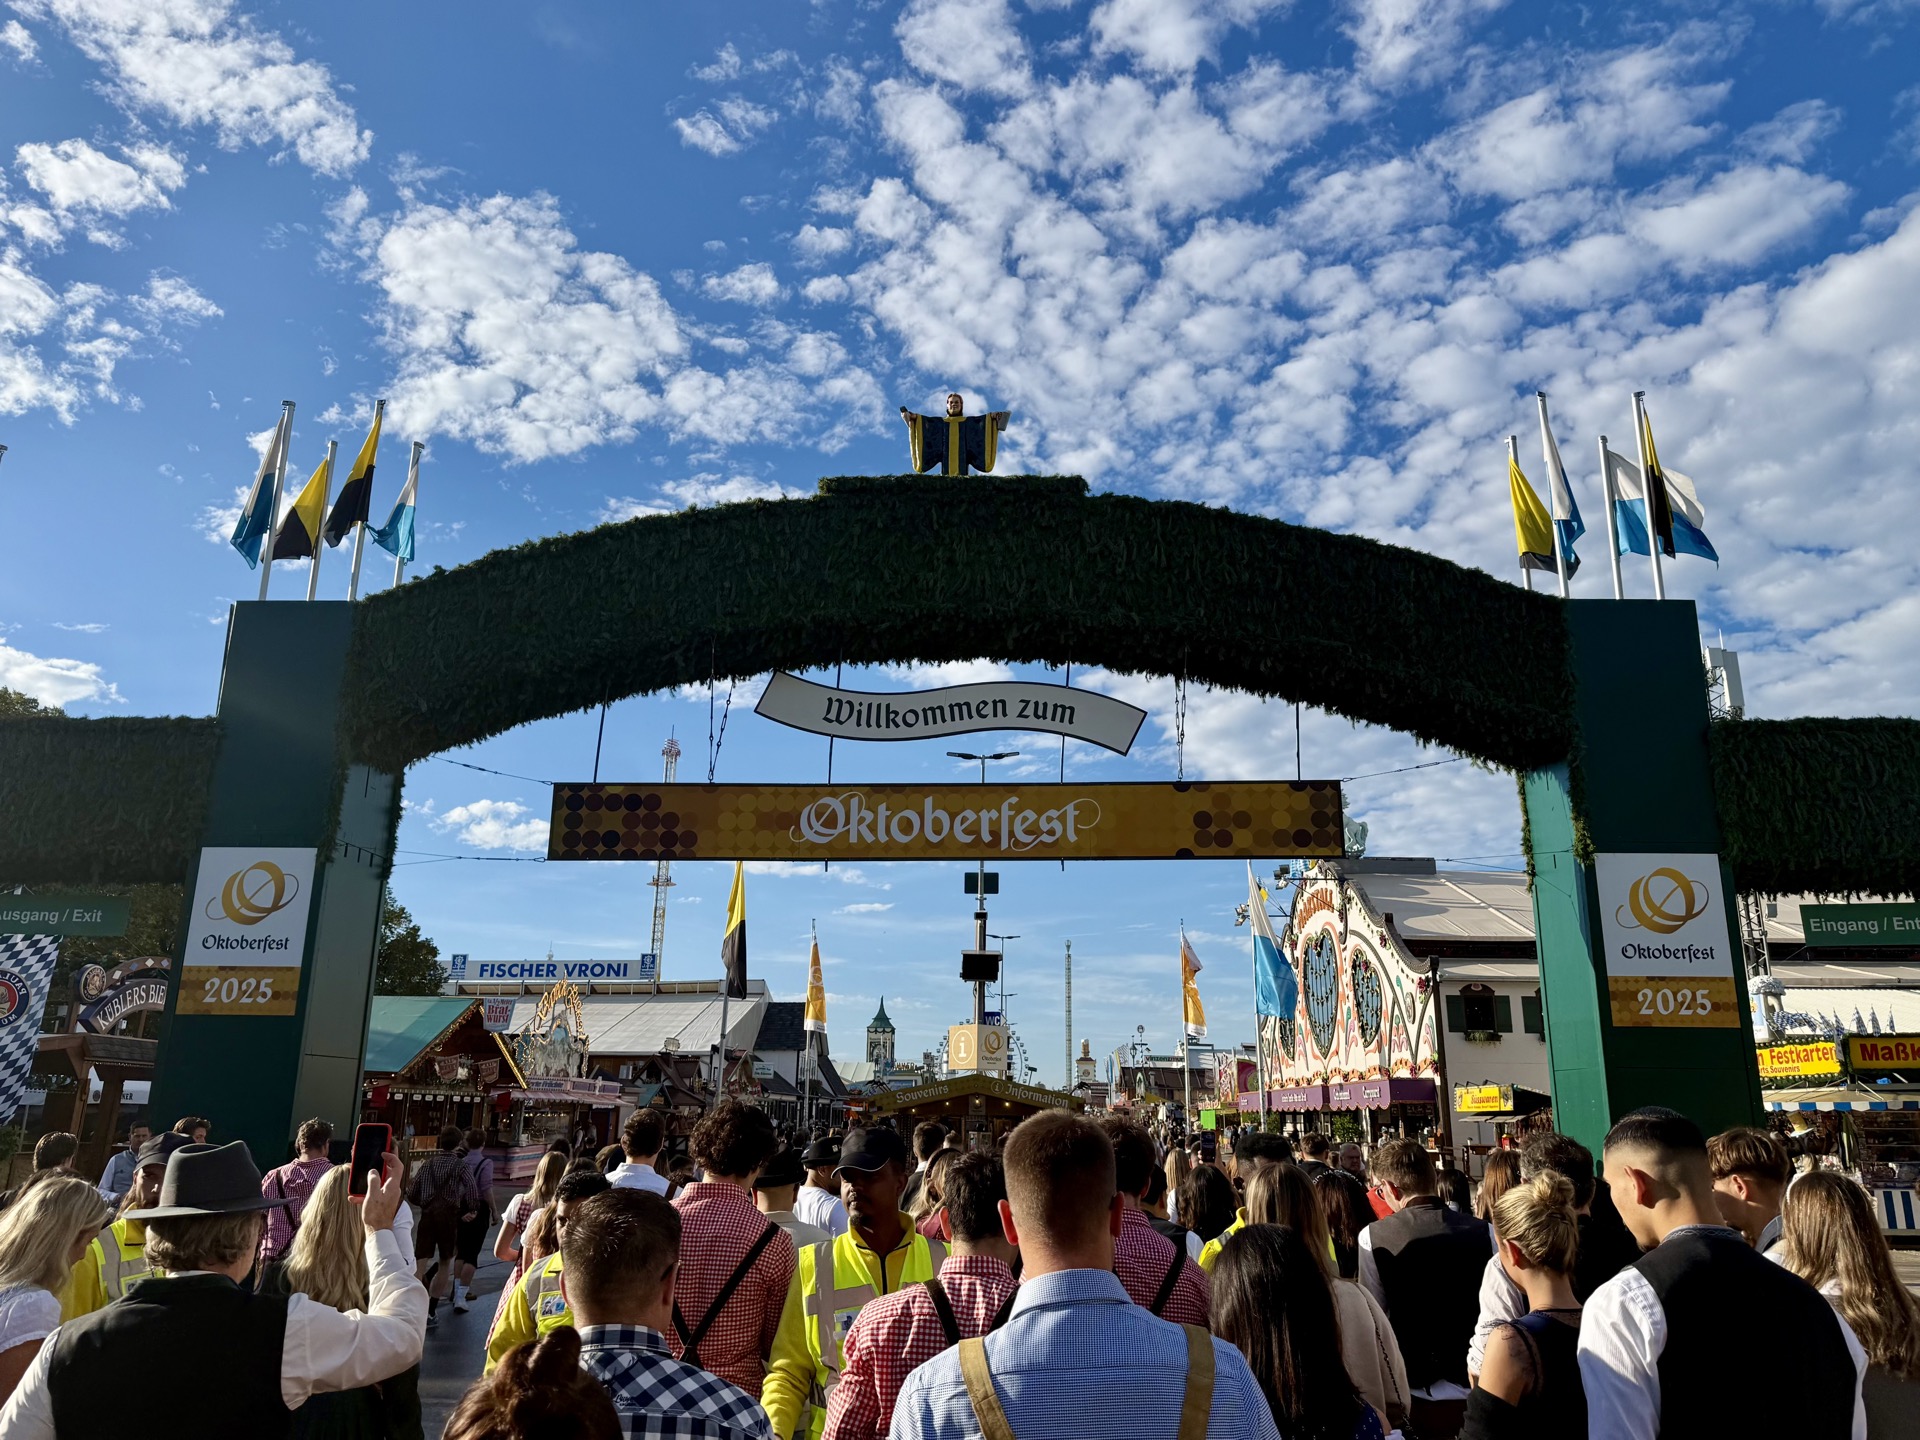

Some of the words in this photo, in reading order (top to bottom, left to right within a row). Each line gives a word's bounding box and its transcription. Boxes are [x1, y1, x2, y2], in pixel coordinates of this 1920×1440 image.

[821, 696, 1009, 730] Willkommen
[1016, 698, 1076, 725] zum
[789, 791, 1101, 852] Oktoberfest
[0, 910, 59, 925] usgang
[72, 909, 103, 923] Exit
[1810, 918, 1879, 935] Eingang
[202, 934, 290, 953] Oktoberfest
[1621, 943, 1716, 963] Oktoberfest
[479, 963, 557, 978] FISCHER
[563, 963, 628, 978] VRONI
[202, 977, 274, 1004] 2025
[96, 984, 147, 1031] KÜBLERS
[1637, 988, 1712, 1016] 2025
[985, 1015, 1000, 1026] WC
[1770, 1065, 1801, 1074] Souvenirs
[896, 1084, 950, 1104] Souvenirs
[1005, 1083, 1070, 1109] Information
